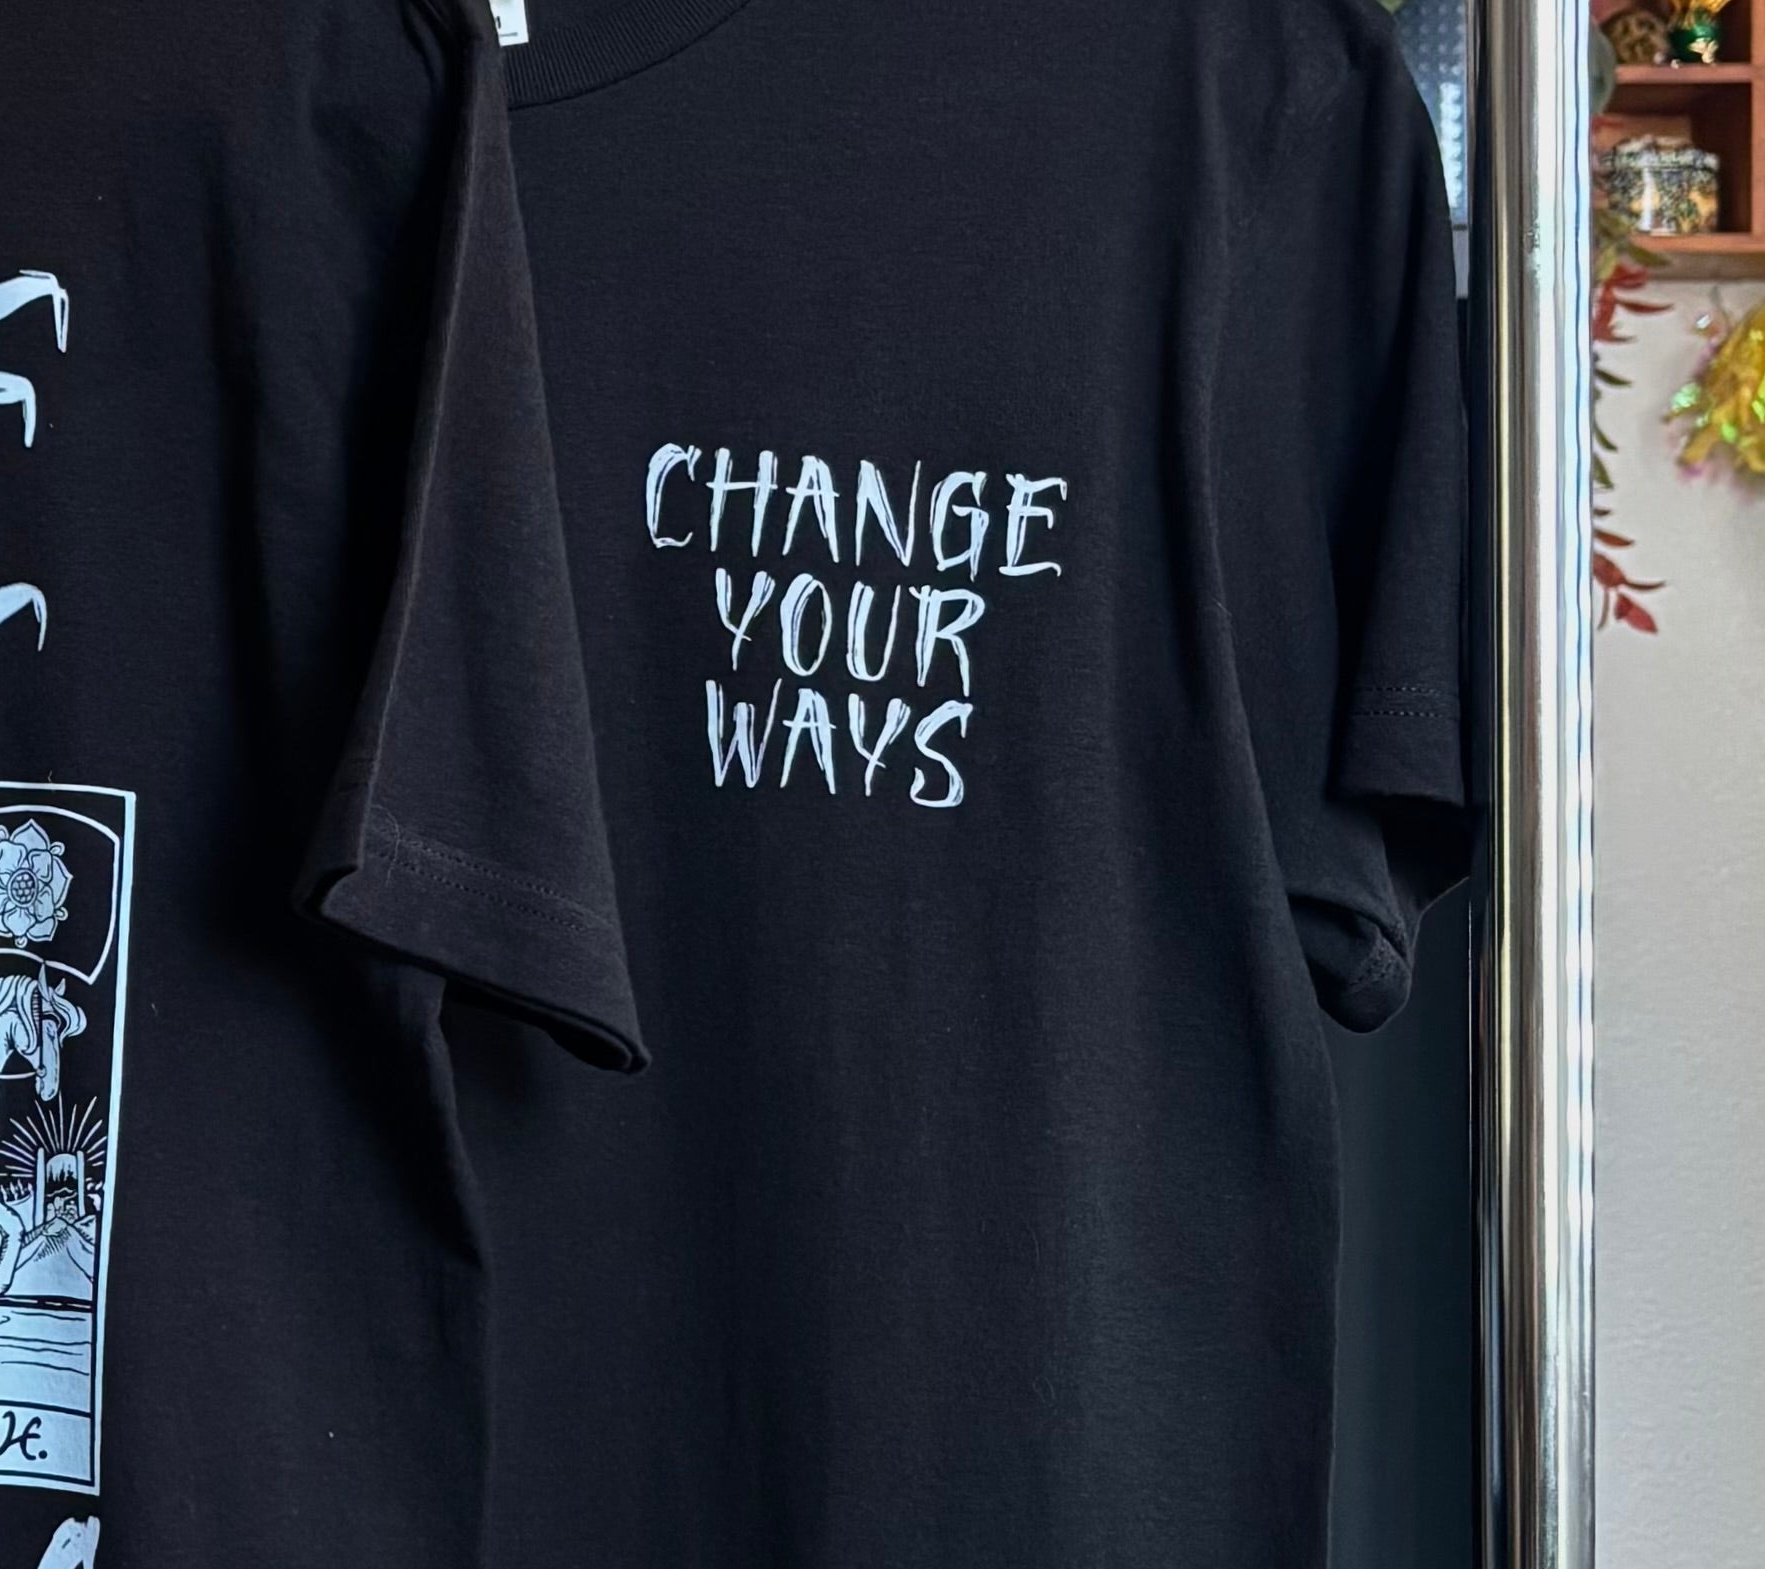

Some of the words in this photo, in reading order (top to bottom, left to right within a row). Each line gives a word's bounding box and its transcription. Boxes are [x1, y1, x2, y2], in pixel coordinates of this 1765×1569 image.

[645, 442, 1068, 582] CHANGE
[715, 567, 986, 697] YOUR
[705, 677, 974, 808] WAYS
